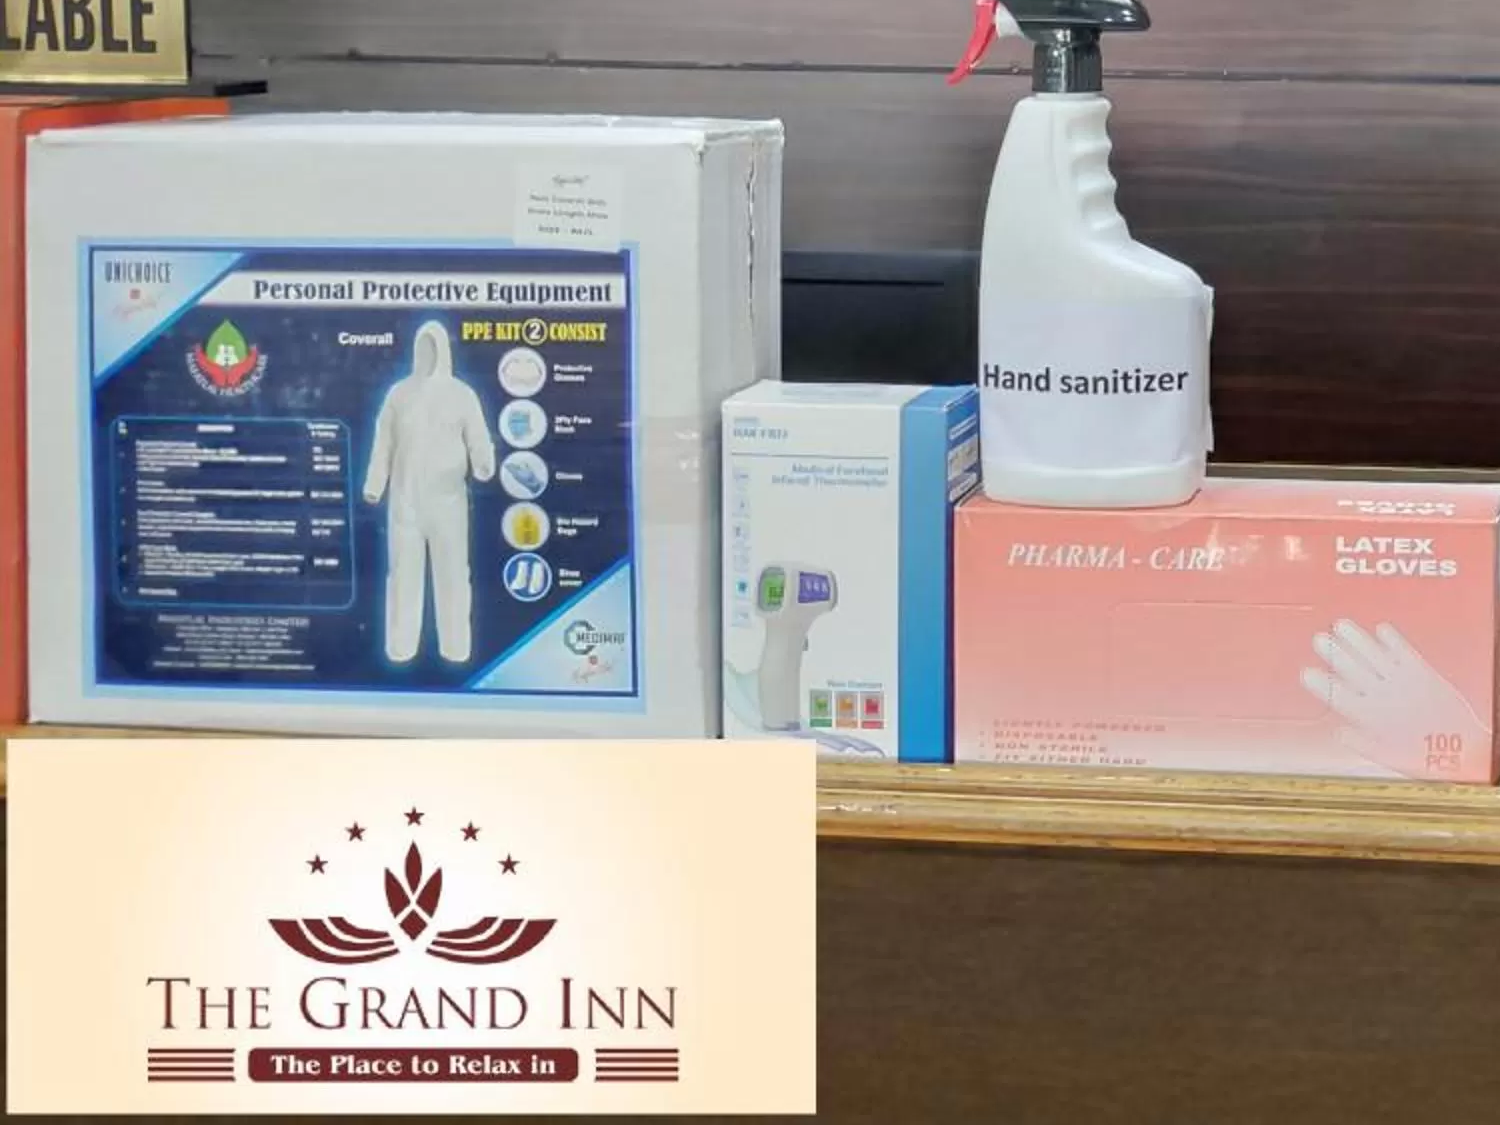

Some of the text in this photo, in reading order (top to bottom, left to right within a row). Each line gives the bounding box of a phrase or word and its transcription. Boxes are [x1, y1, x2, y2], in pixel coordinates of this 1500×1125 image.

[105, 261, 172, 283] UNICHOICE
[253, 280, 612, 304] Personal Protective Equipment
[338, 332, 393, 345] Coverall
[462, 322, 493, 340] PPE
[495, 322, 521, 340] KIT
[550, 323, 606, 341] CONSIST
[983, 363, 1189, 395] Hand sanitizer
[1335, 536, 1434, 554] LATEX
[1007, 543, 1126, 569] PHARMA
[1150, 546, 1226, 572] CARE
[1335, 558, 1457, 576] GLOVES
[1424, 733, 1462, 752] 100
[1426, 754, 1462, 771] PCS
